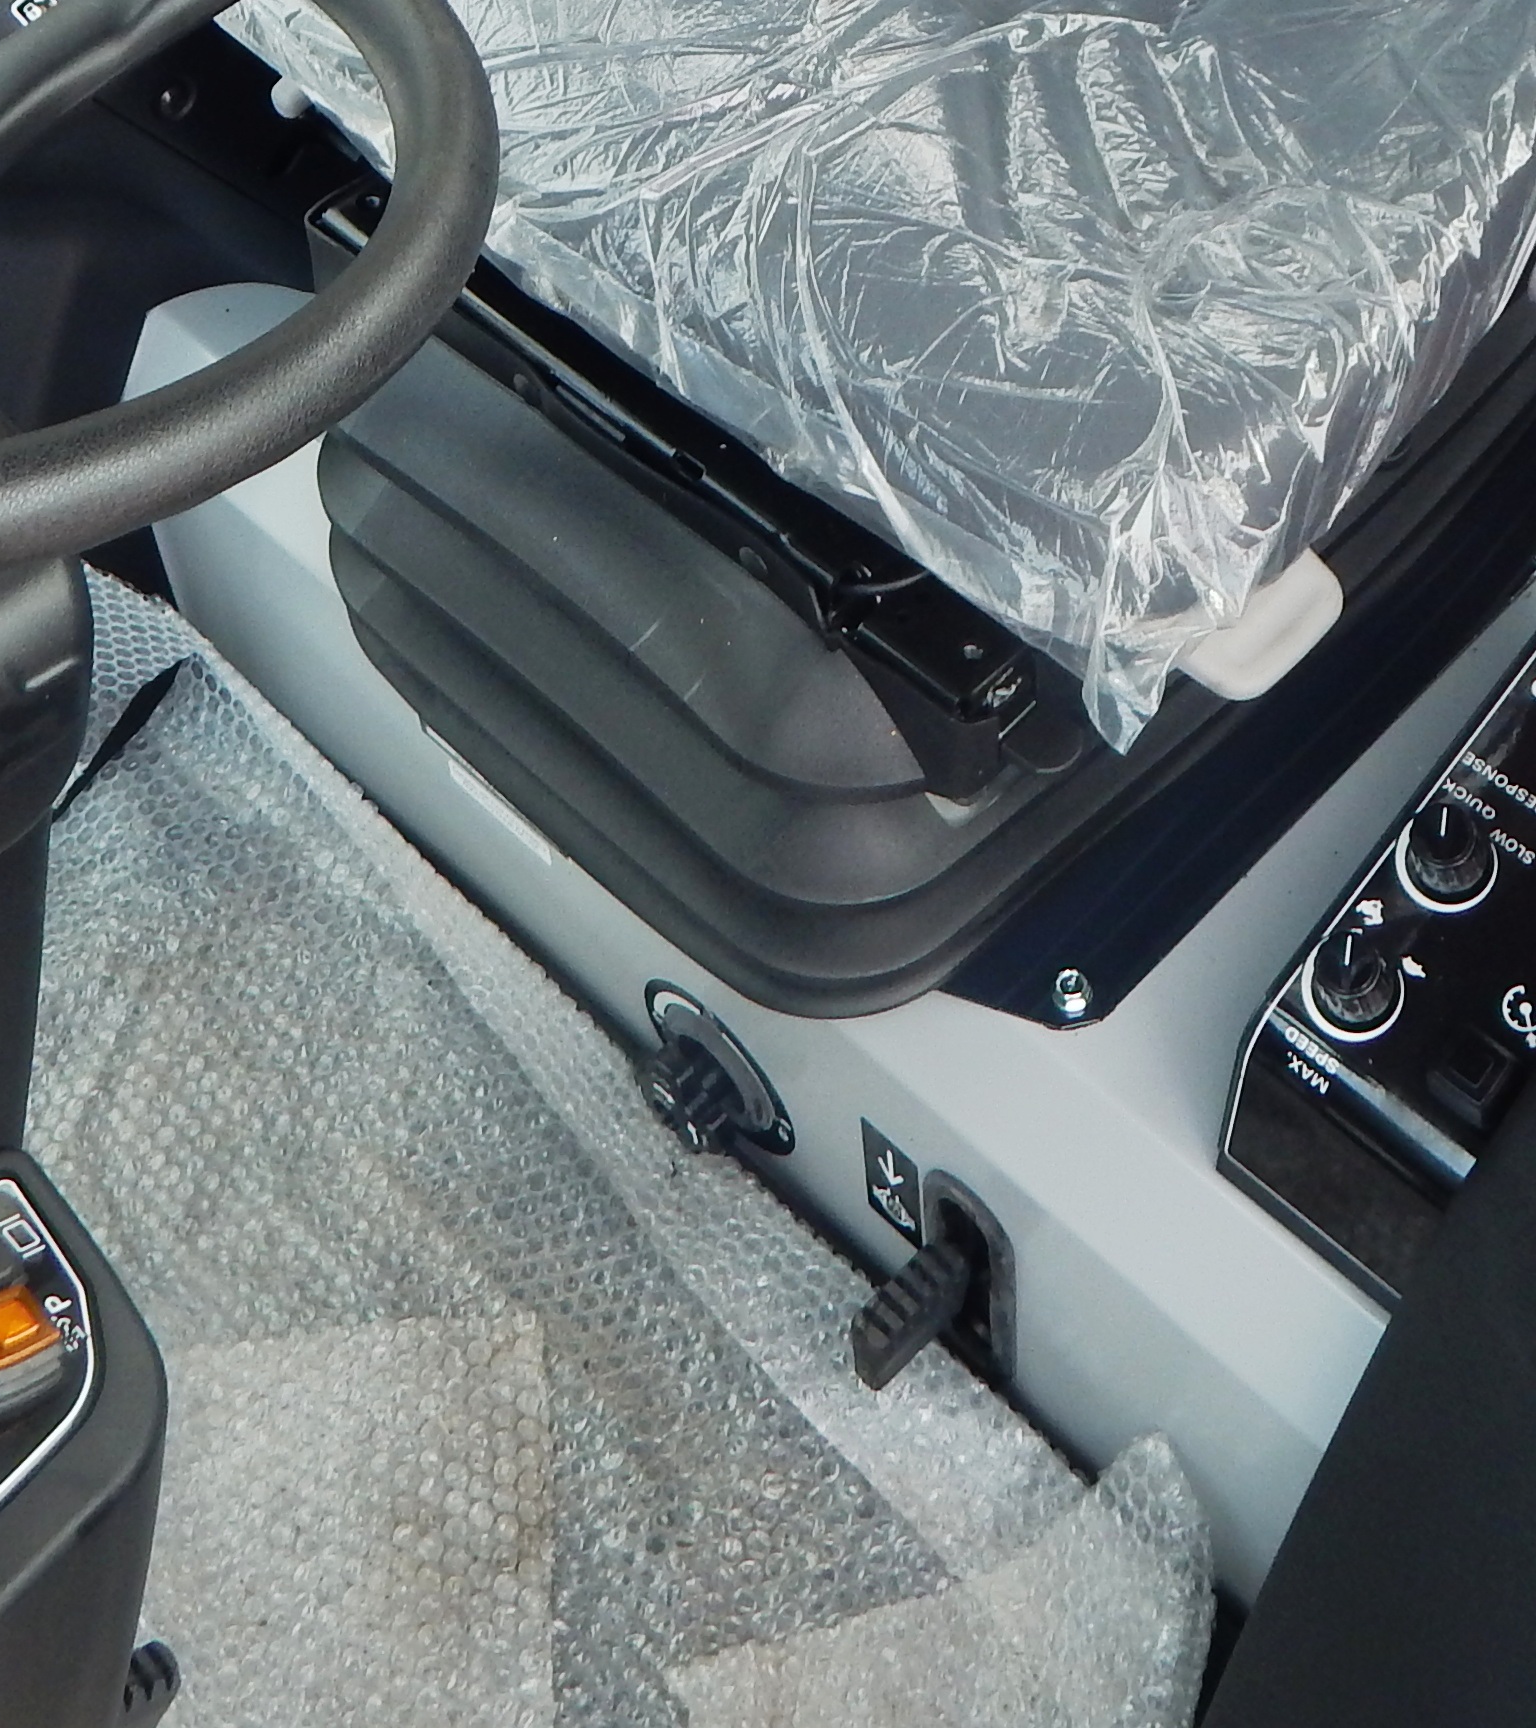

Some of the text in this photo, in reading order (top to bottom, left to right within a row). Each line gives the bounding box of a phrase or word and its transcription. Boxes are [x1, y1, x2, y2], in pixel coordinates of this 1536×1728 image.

[1442, 777, 1536, 865] SLOW QUICK
[1284, 1026, 1340, 1075] SPEED
[1287, 1050, 1330, 1094] MAX.
